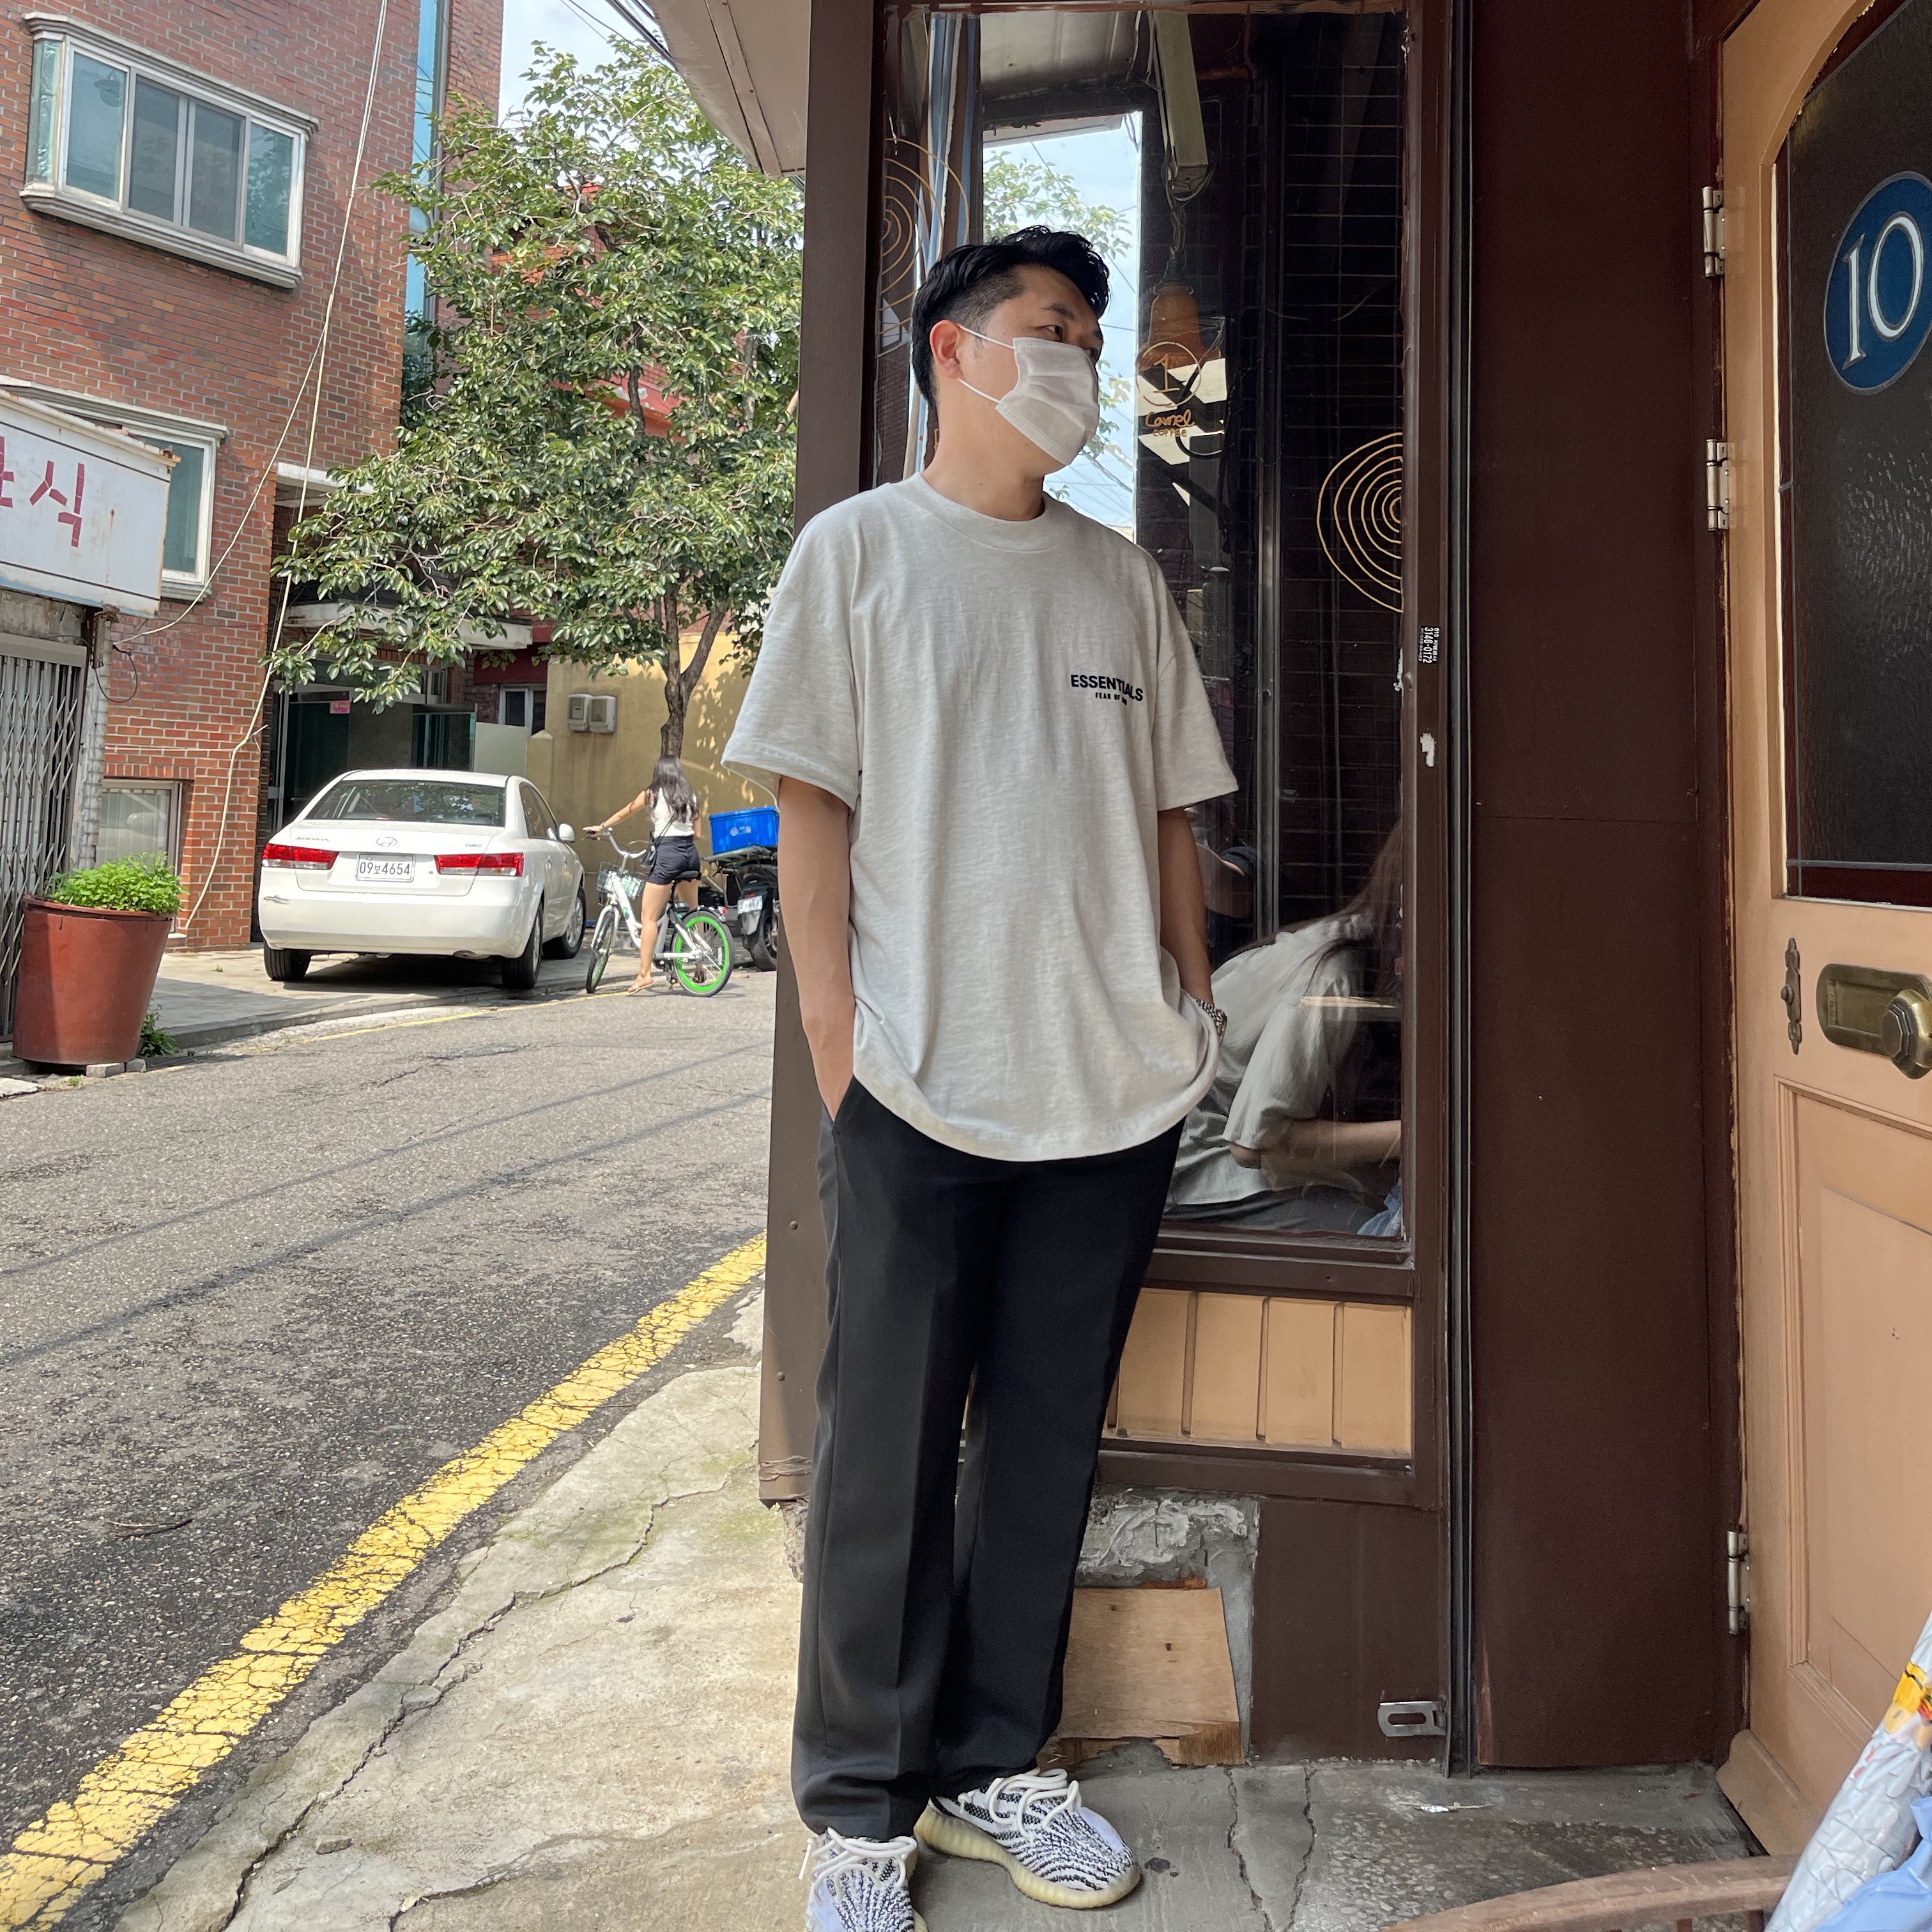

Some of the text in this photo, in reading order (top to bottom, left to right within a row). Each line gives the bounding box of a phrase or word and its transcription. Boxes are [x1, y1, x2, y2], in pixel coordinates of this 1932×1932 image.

[1841, 211, 1924, 369] 10
[1154, 353, 1180, 392] 1
[1145, 409, 1195, 427] Camel
[1153, 428, 1187, 437] COFFEE
[1070, 674, 1144, 702] ESSENTIALS
[359, 861, 411, 876] 09보4654
